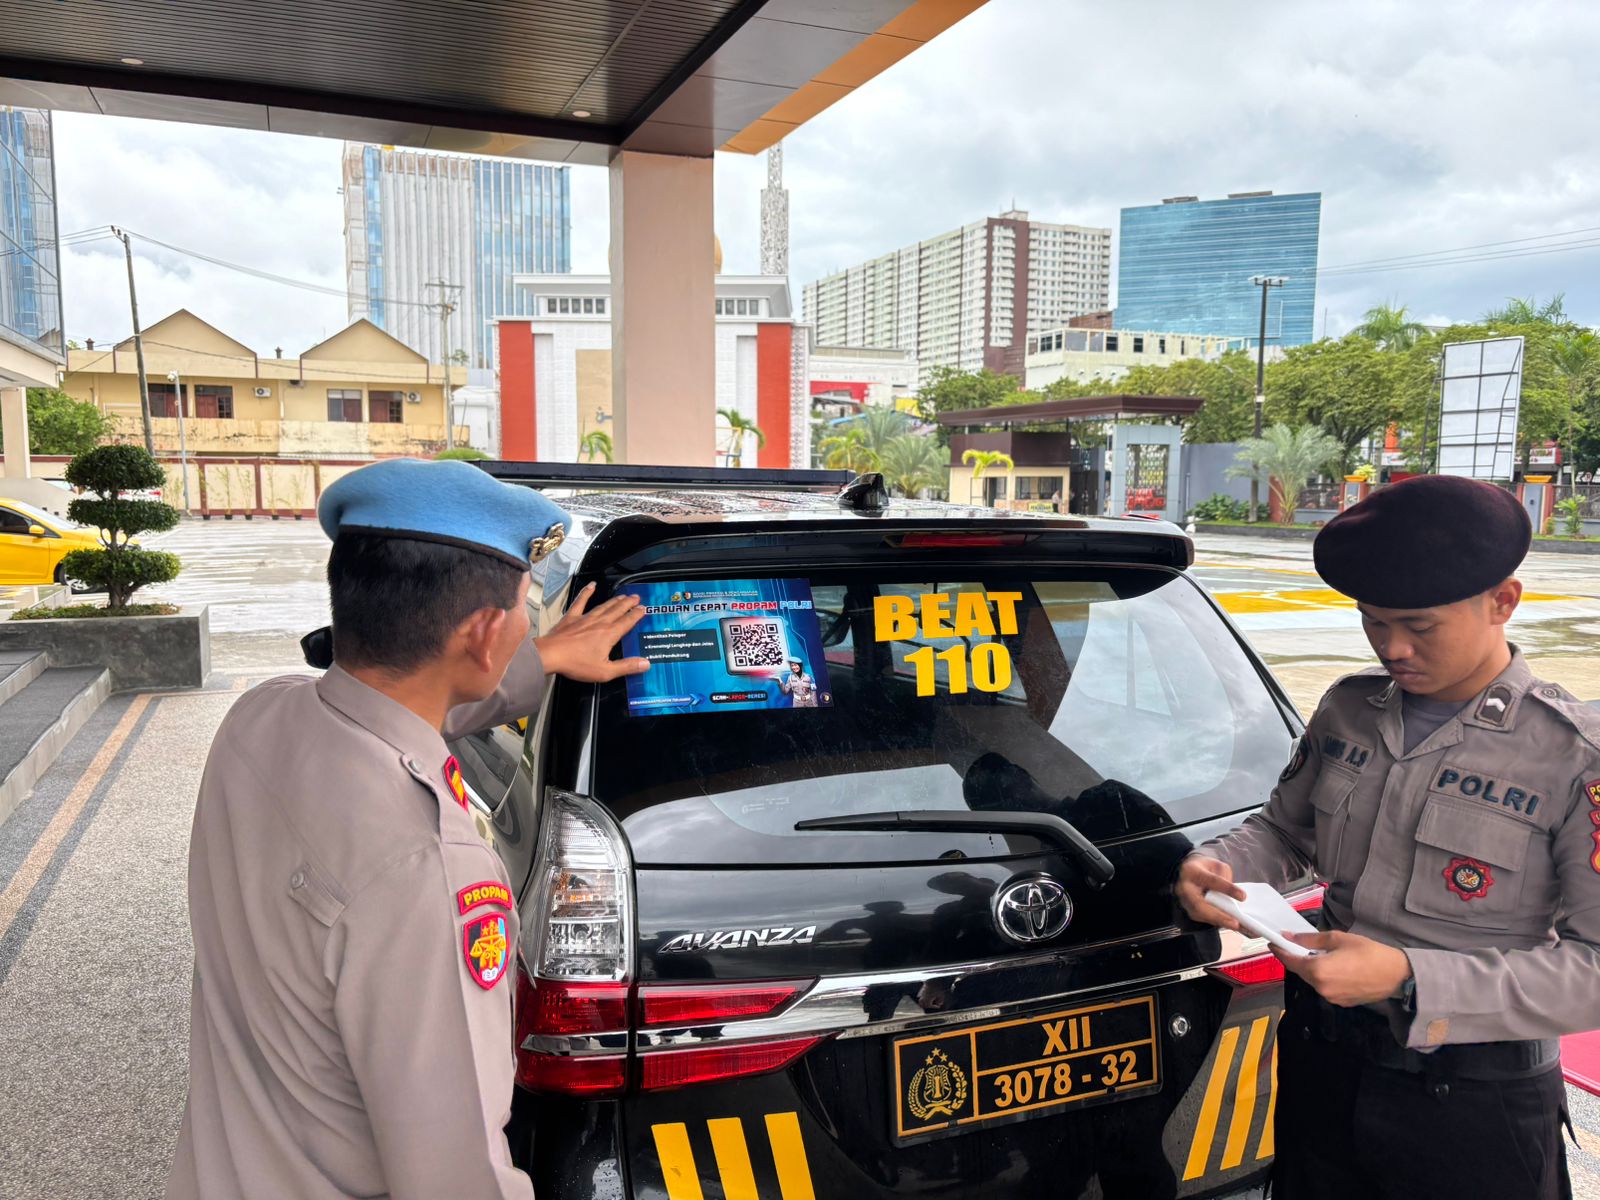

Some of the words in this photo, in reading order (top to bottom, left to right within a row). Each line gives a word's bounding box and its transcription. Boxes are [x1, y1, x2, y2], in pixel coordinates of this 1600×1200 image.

[645, 604, 691, 614] GADUAN
[693, 602, 728, 612] CEPAT
[731, 600, 778, 611] PROPAM
[780, 600, 813, 610] POLRI
[873, 591, 1023, 643] BEAT
[903, 642, 1012, 698] 110
[1437, 768, 1540, 817] POLRI
[463, 885, 509, 906] PROPAM
[657, 925, 817, 954] AVANZA
[1041, 1016, 1092, 1056] XII
[993, 1062, 1073, 1108] 3078
[1101, 1050, 1138, 1087] 32
